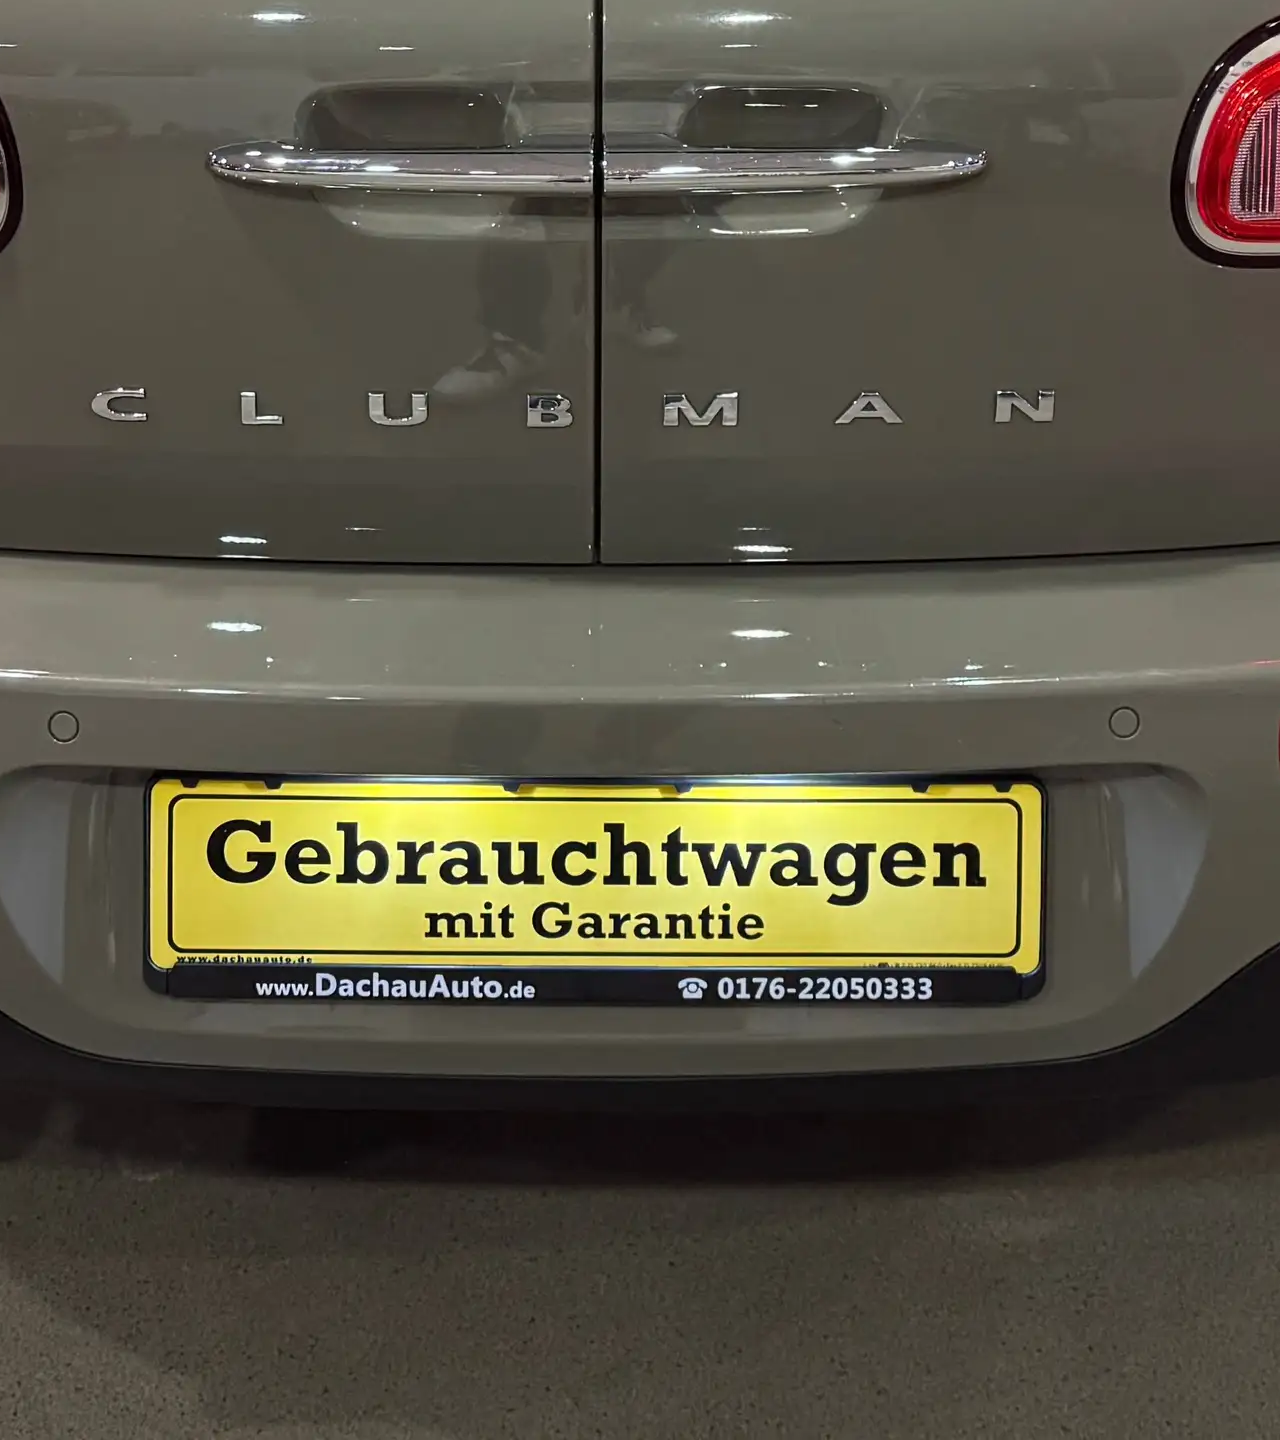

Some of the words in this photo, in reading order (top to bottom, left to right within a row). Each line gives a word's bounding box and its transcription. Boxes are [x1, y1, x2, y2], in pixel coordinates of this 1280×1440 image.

[206, 819, 987, 906] Gebrauchtwagen
[424, 902, 515, 939] mit
[531, 902, 765, 940] Garantie
[255, 972, 536, 1000] www.DachauAuto.de
[717, 977, 933, 1001] 0176-22050333
